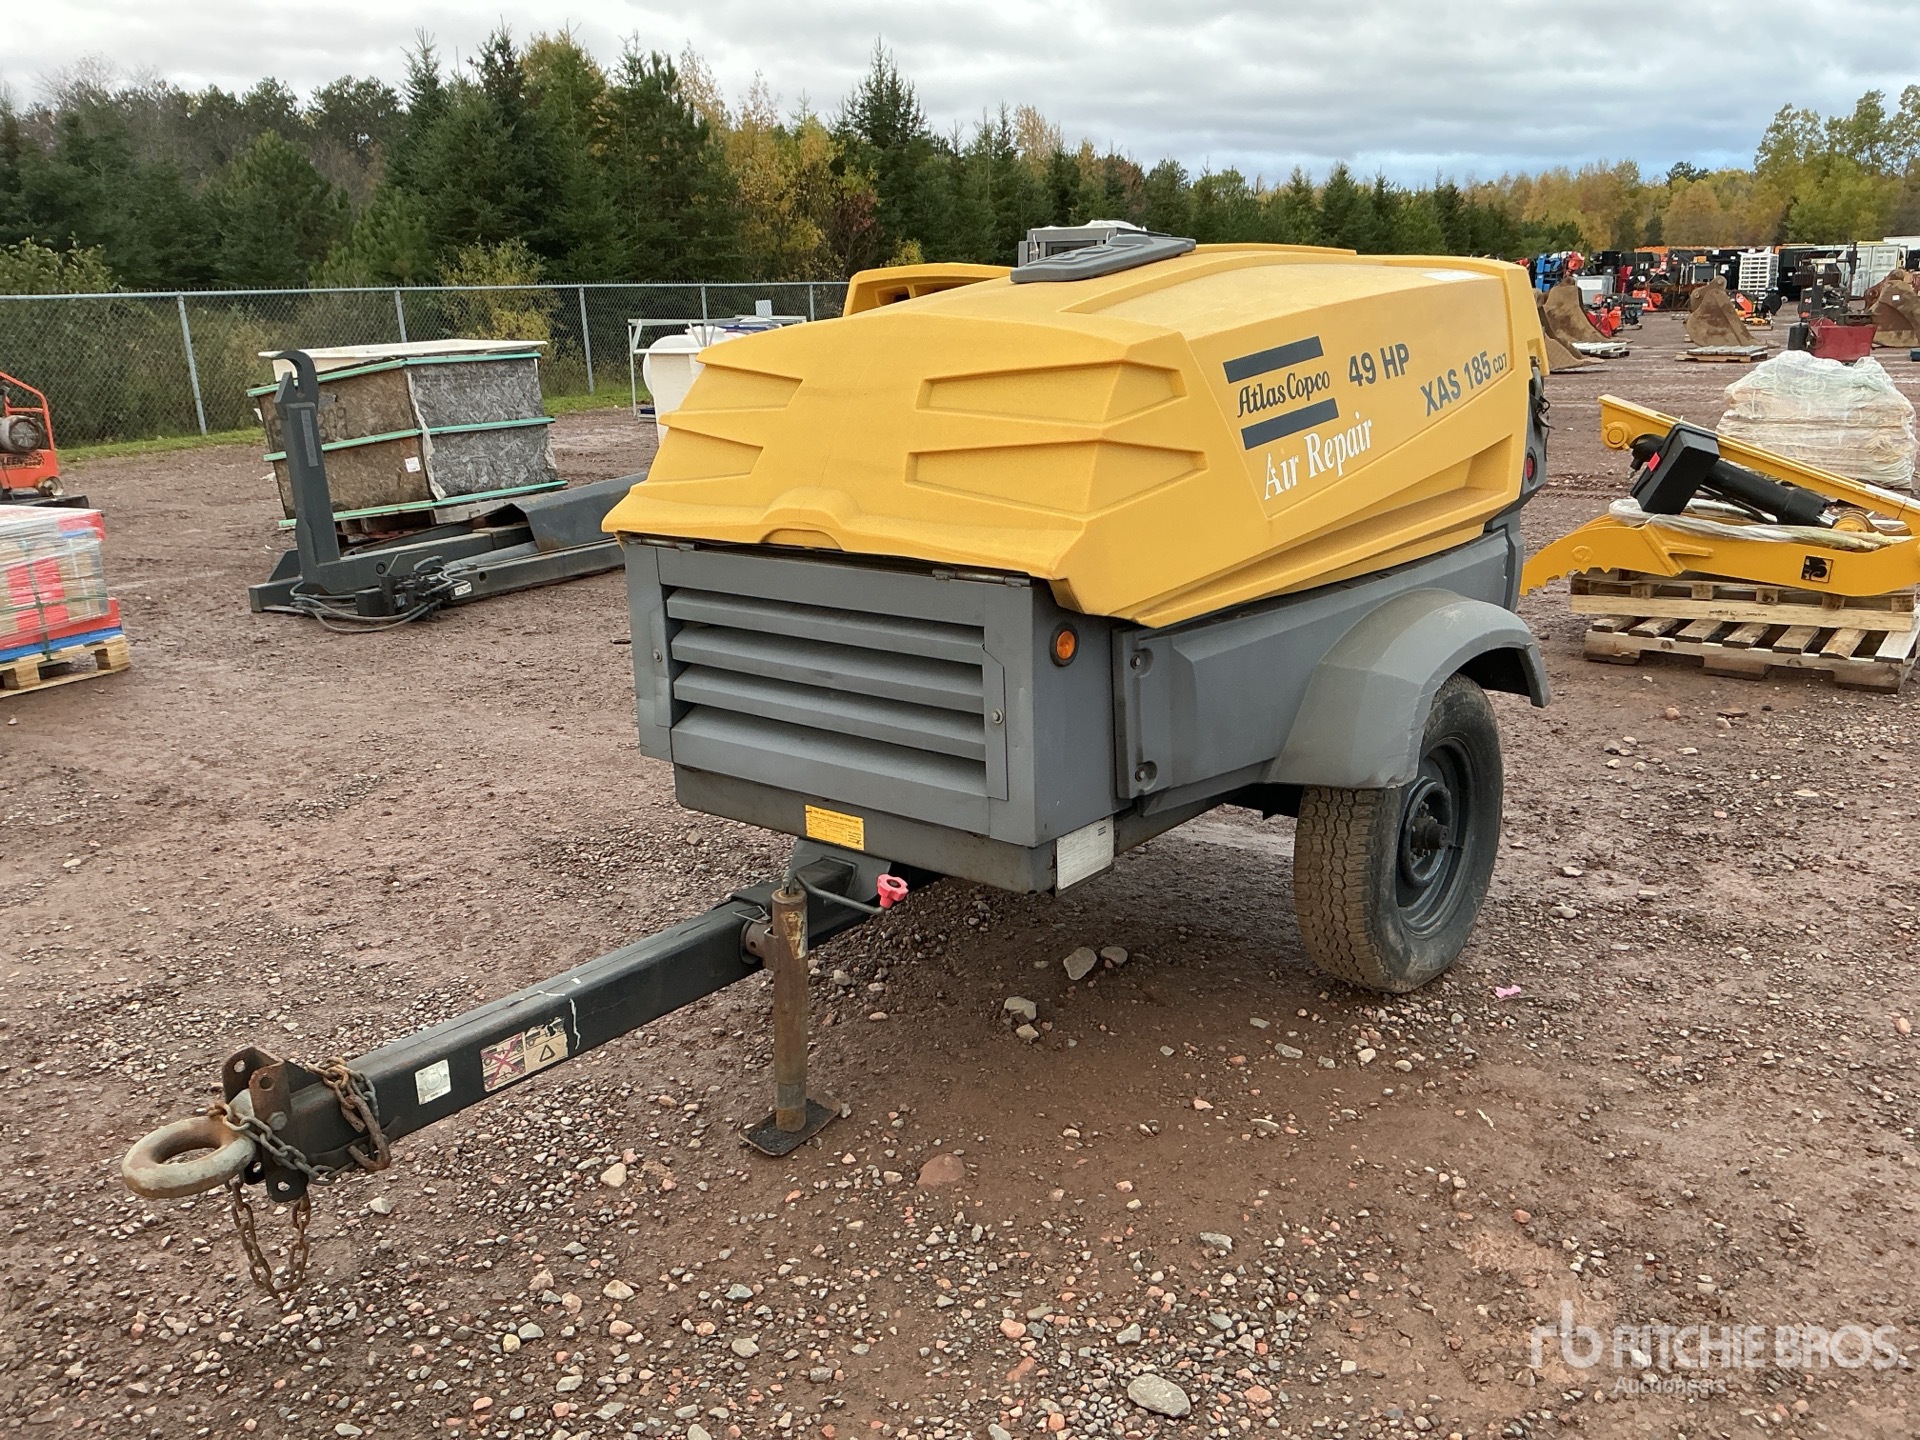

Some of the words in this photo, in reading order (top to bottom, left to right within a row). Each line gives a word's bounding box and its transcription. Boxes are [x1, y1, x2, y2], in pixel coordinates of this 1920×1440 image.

[1349, 352, 1377, 387] 49
[1379, 343, 1410, 379] HP
[1420, 368, 1462, 417] XAS
[1463, 350, 1492, 390] 185
[1237, 382, 1286, 418] Atlas
[1286, 371, 1330, 402] Copco
[1264, 451, 1299, 501] Air
[1303, 410, 1373, 478] Repair
